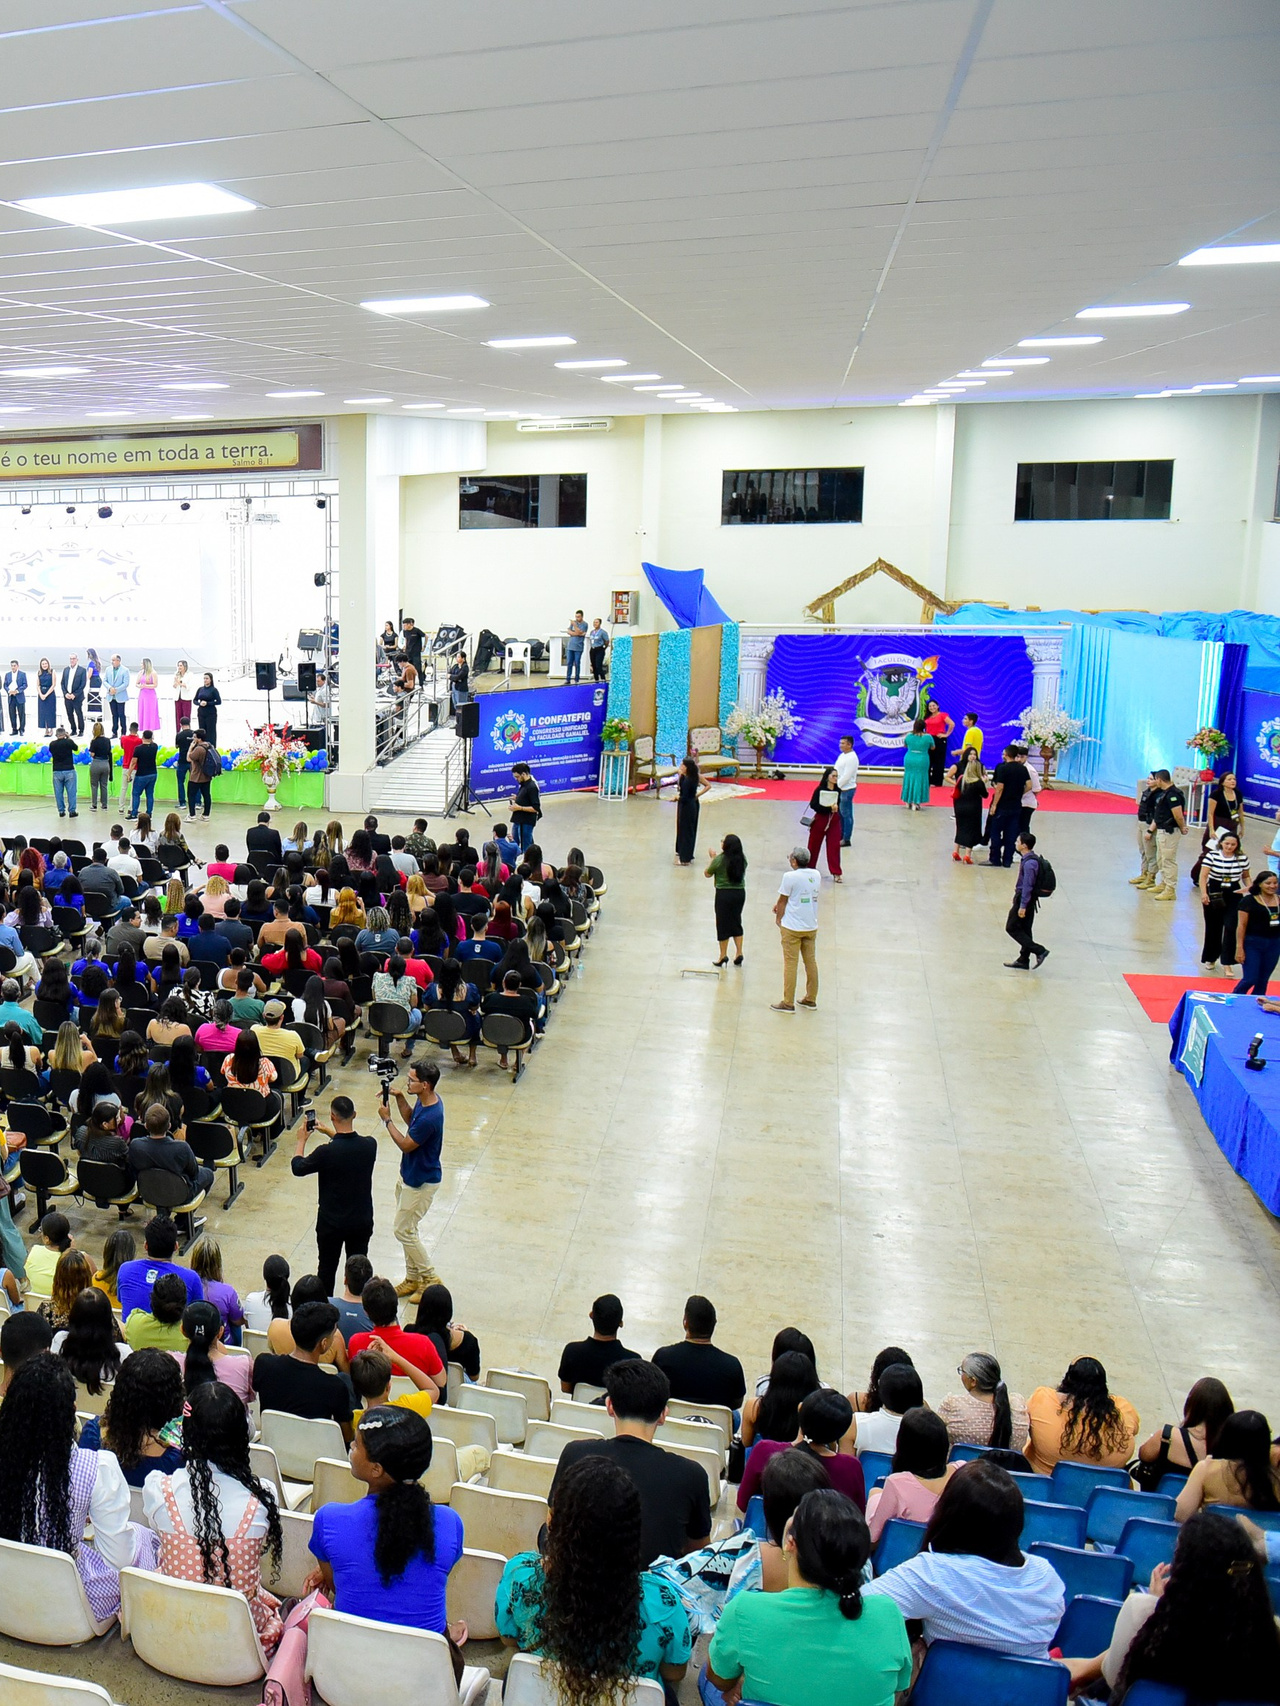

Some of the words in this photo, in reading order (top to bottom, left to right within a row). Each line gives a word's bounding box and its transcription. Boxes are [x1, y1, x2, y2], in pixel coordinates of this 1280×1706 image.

[1, 451, 11, 467] é
[16, 454, 28, 467] o
[33, 451, 61, 466] teu
[67, 450, 118, 465] nome
[123, 449, 152, 462] em
[157, 444, 200, 461] toda
[205, 446, 215, 459] a
[221, 444, 274, 459] terra.
[232, 458, 255, 467] Salmo
[530, 718, 536, 726] II
[538, 712, 590, 726] CONFATEFIG
